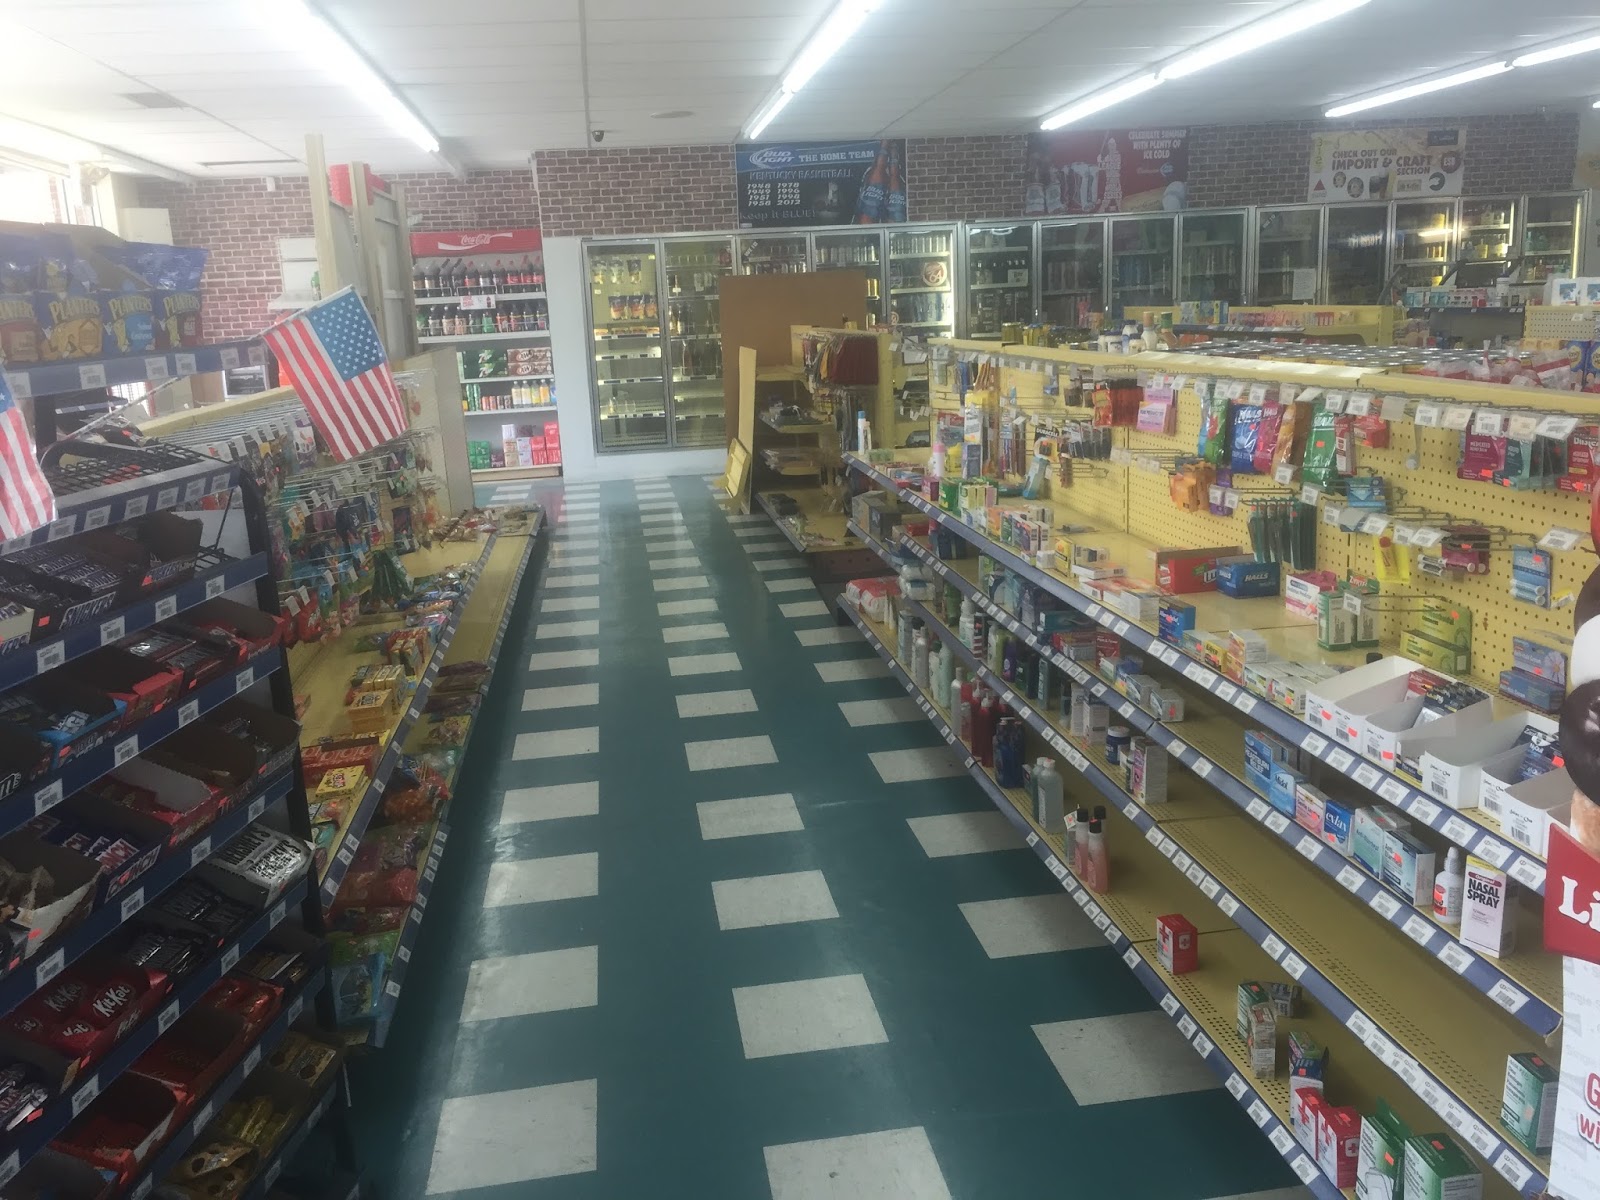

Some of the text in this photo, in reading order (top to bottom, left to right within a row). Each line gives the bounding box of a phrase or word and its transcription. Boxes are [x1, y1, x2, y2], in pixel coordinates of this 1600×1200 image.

[1150, 140, 1171, 149] PLENTY
[757, 156, 795, 164] LIGHT
[799, 150, 875, 163] THE HOME TEAM
[1143, 149, 1170, 160] ICE COLD
[1332, 148, 1397, 159] CHECK OUT OUR
[1332, 155, 1433, 171] IMPORT & CRAFT
[750, 168, 853, 181] KENTUCKY BASKETBALL
[1397, 167, 1431, 176] SECTION
[49, 298, 101, 324] PLANTERS
[108, 295, 153, 321] PLANTERS
[163, 293, 200, 317] PLANTERS
[1244, 572, 1269, 582] HALLS
[1468, 878, 1500, 899] NASAL
[1467, 889, 1500, 909] SPRAY
